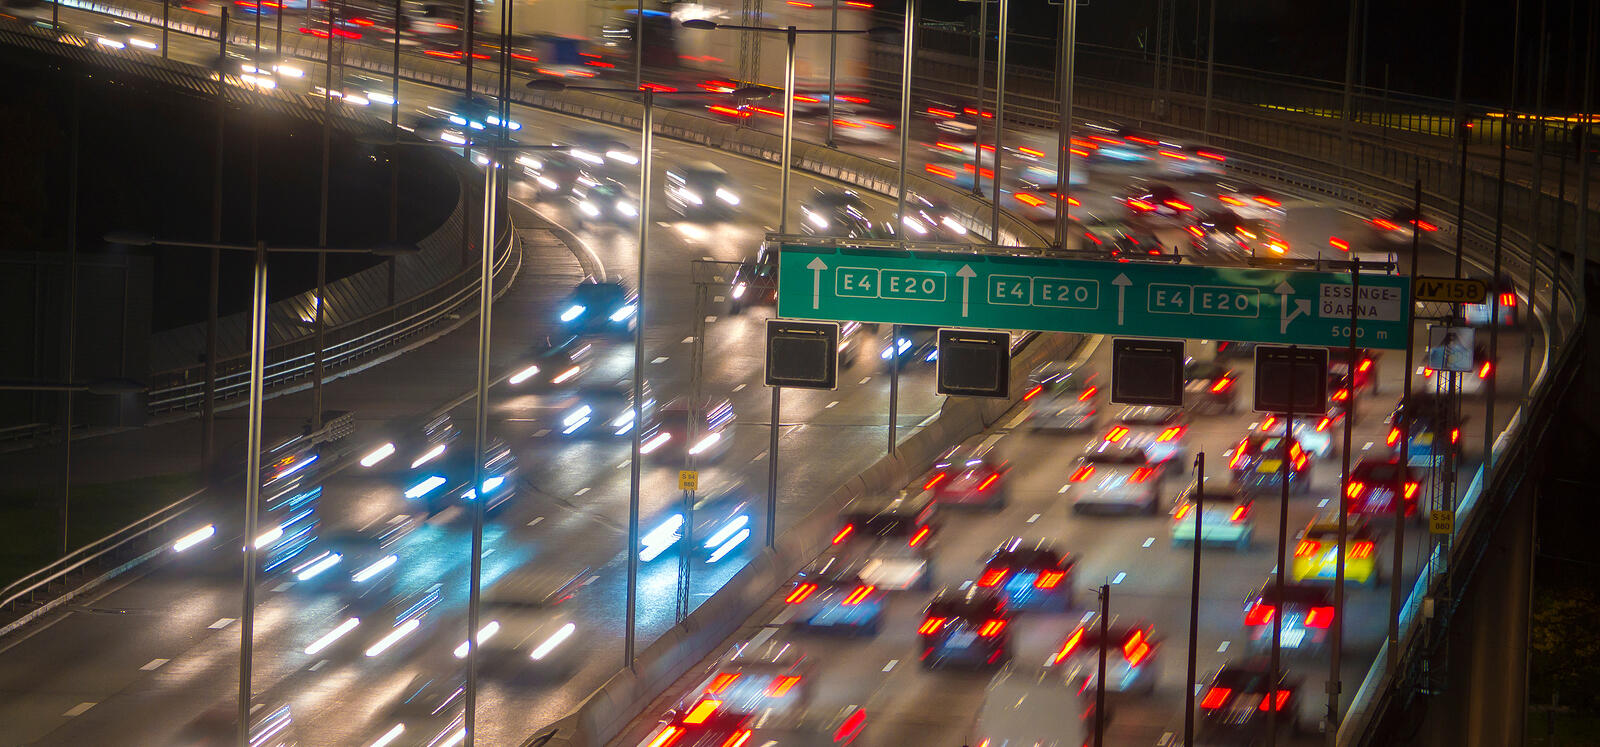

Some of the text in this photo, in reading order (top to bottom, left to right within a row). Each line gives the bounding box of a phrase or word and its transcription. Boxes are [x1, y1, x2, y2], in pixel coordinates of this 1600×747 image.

[844, 274, 936, 294] E4 E20
[996, 282, 1088, 302] E4 E20
[1447, 283, 1478, 298] 158
[1156, 291, 1249, 311] E4 E20
[1324, 286, 1398, 300] ESSNGE-
[1331, 325, 1388, 340] 500 m
